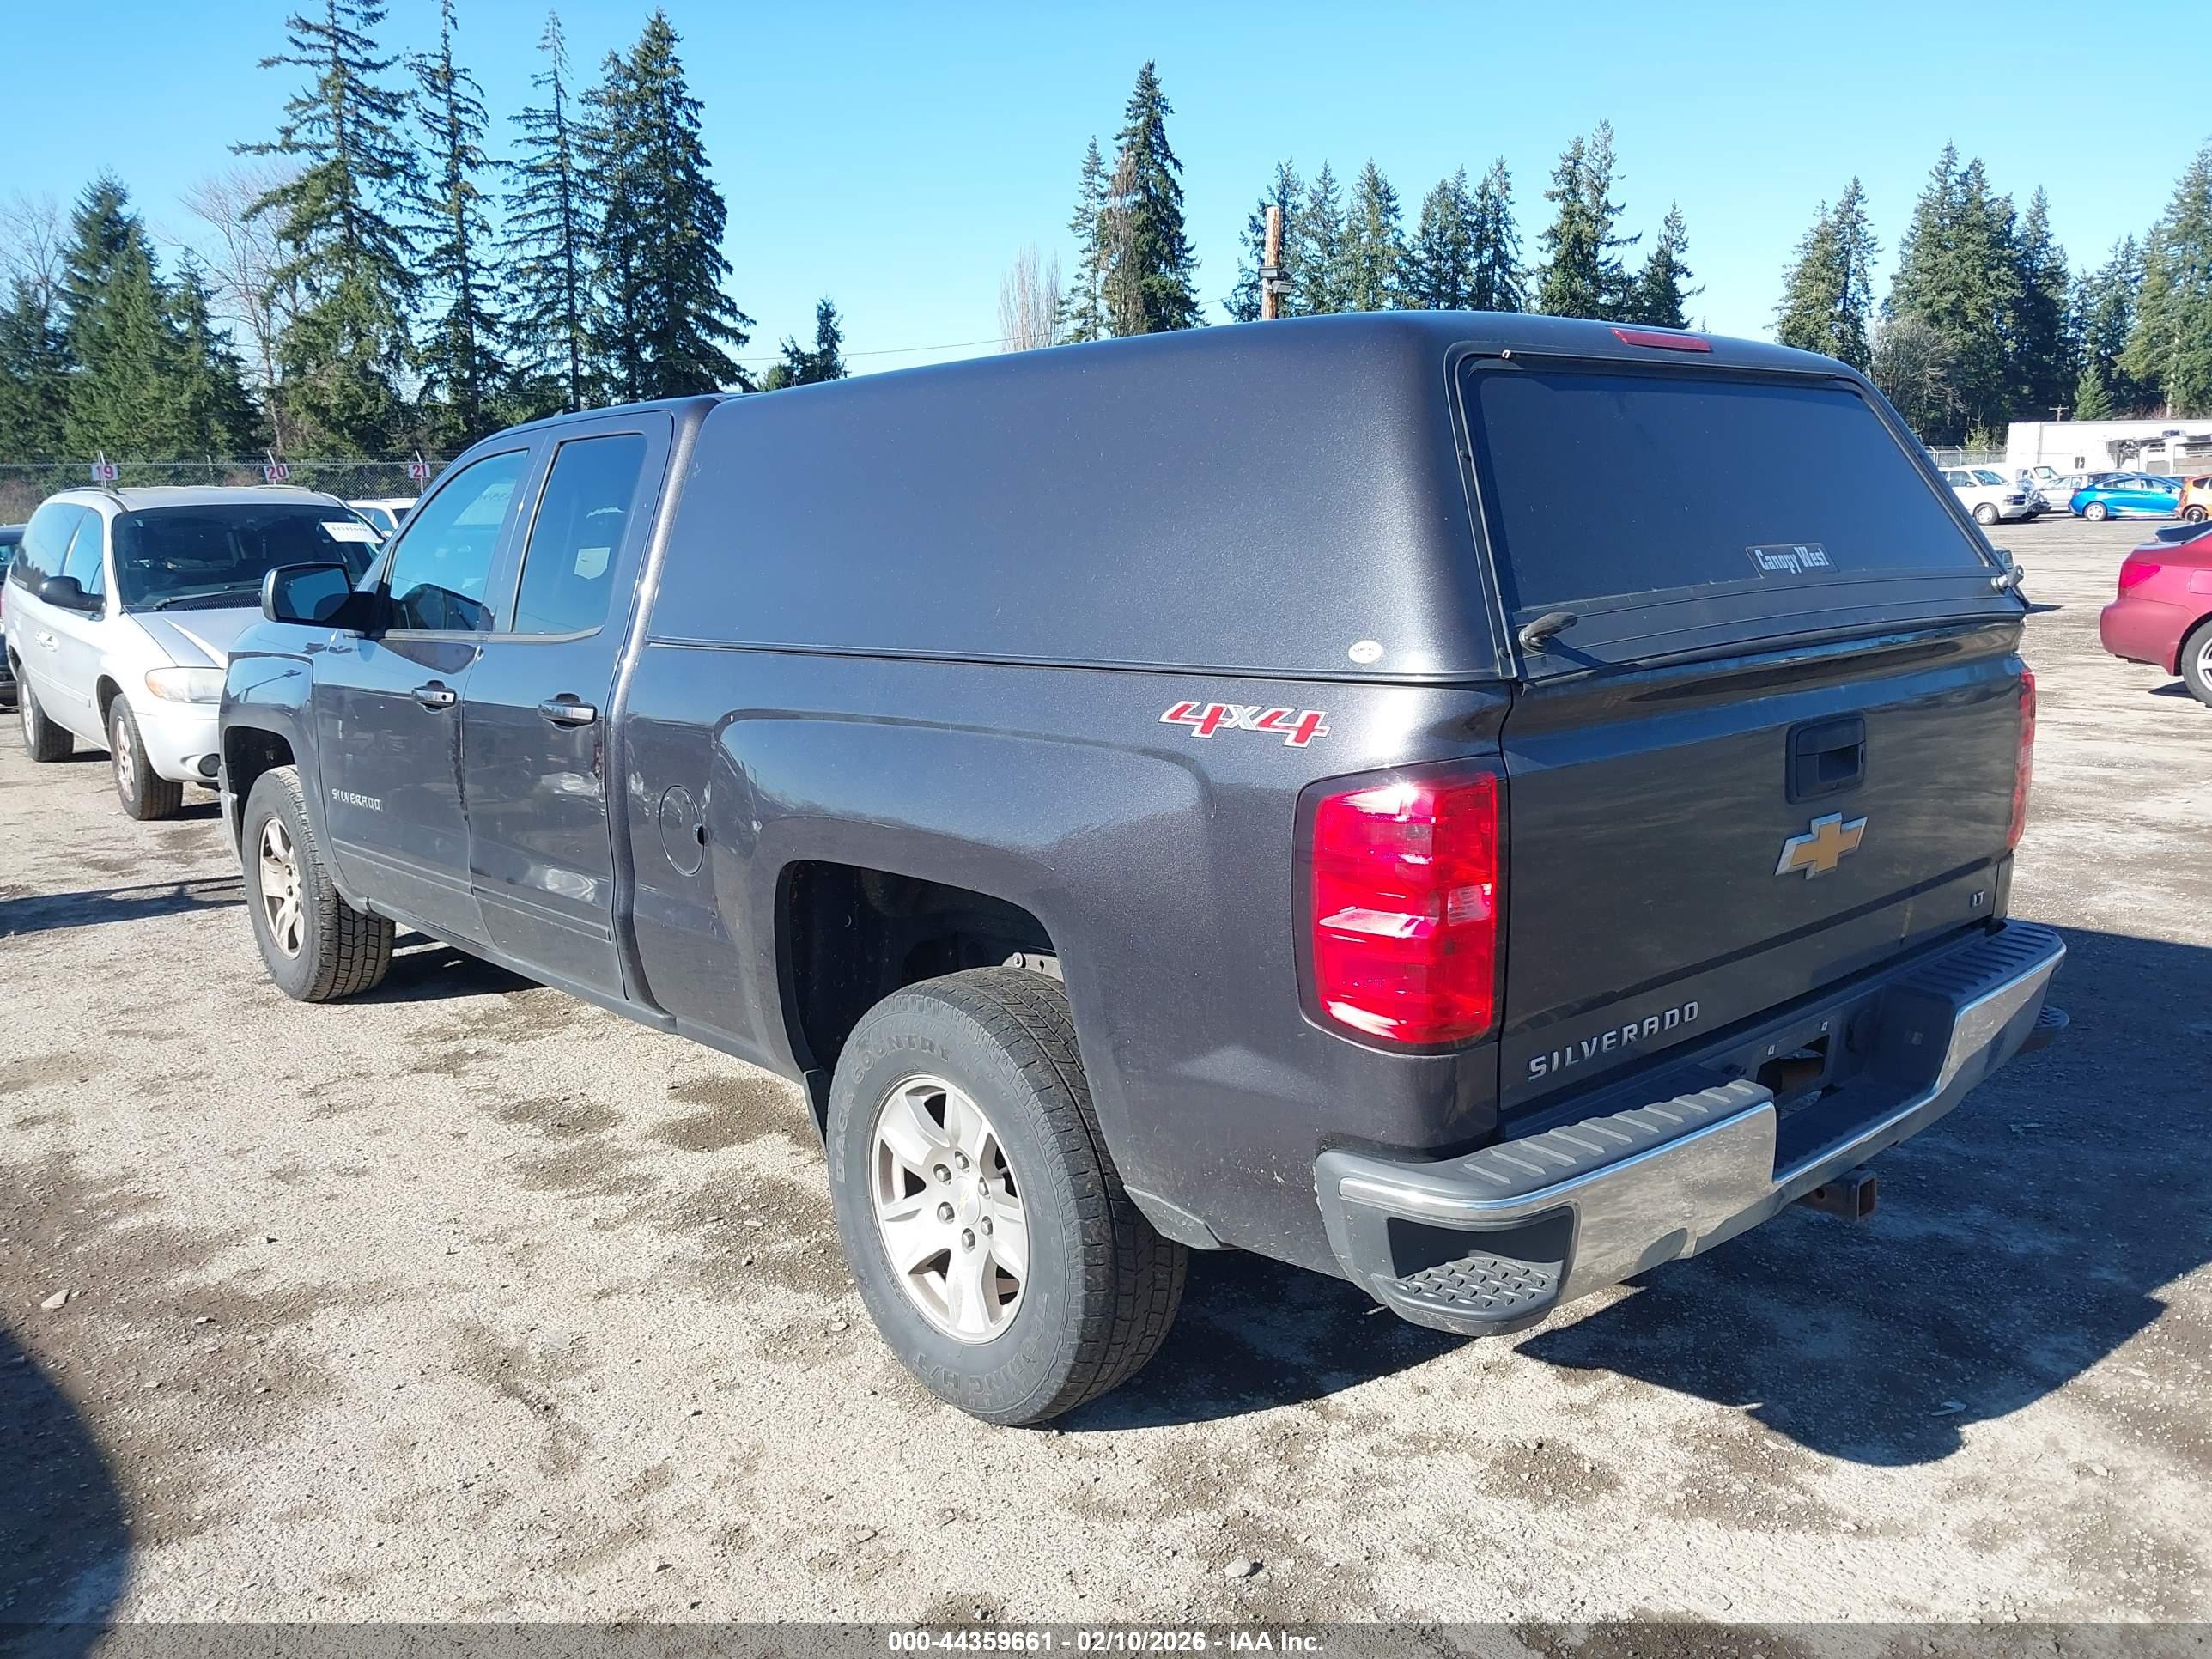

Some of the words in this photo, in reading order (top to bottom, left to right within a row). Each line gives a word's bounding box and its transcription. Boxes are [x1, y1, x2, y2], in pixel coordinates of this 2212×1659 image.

[96, 465, 113, 479] 19
[267, 465, 287, 479] 20
[412, 465, 427, 477] 21
[1754, 549, 1802, 574] Canopy
[1794, 546, 1830, 568] West
[331, 788, 383, 811] SILVERADO
[1972, 891, 1985, 908] LT
[1527, 1001, 1699, 1080] SILVERADO
[835, 1091, 855, 1183] BACK
[852, 1034, 952, 1085] COUNTRY
